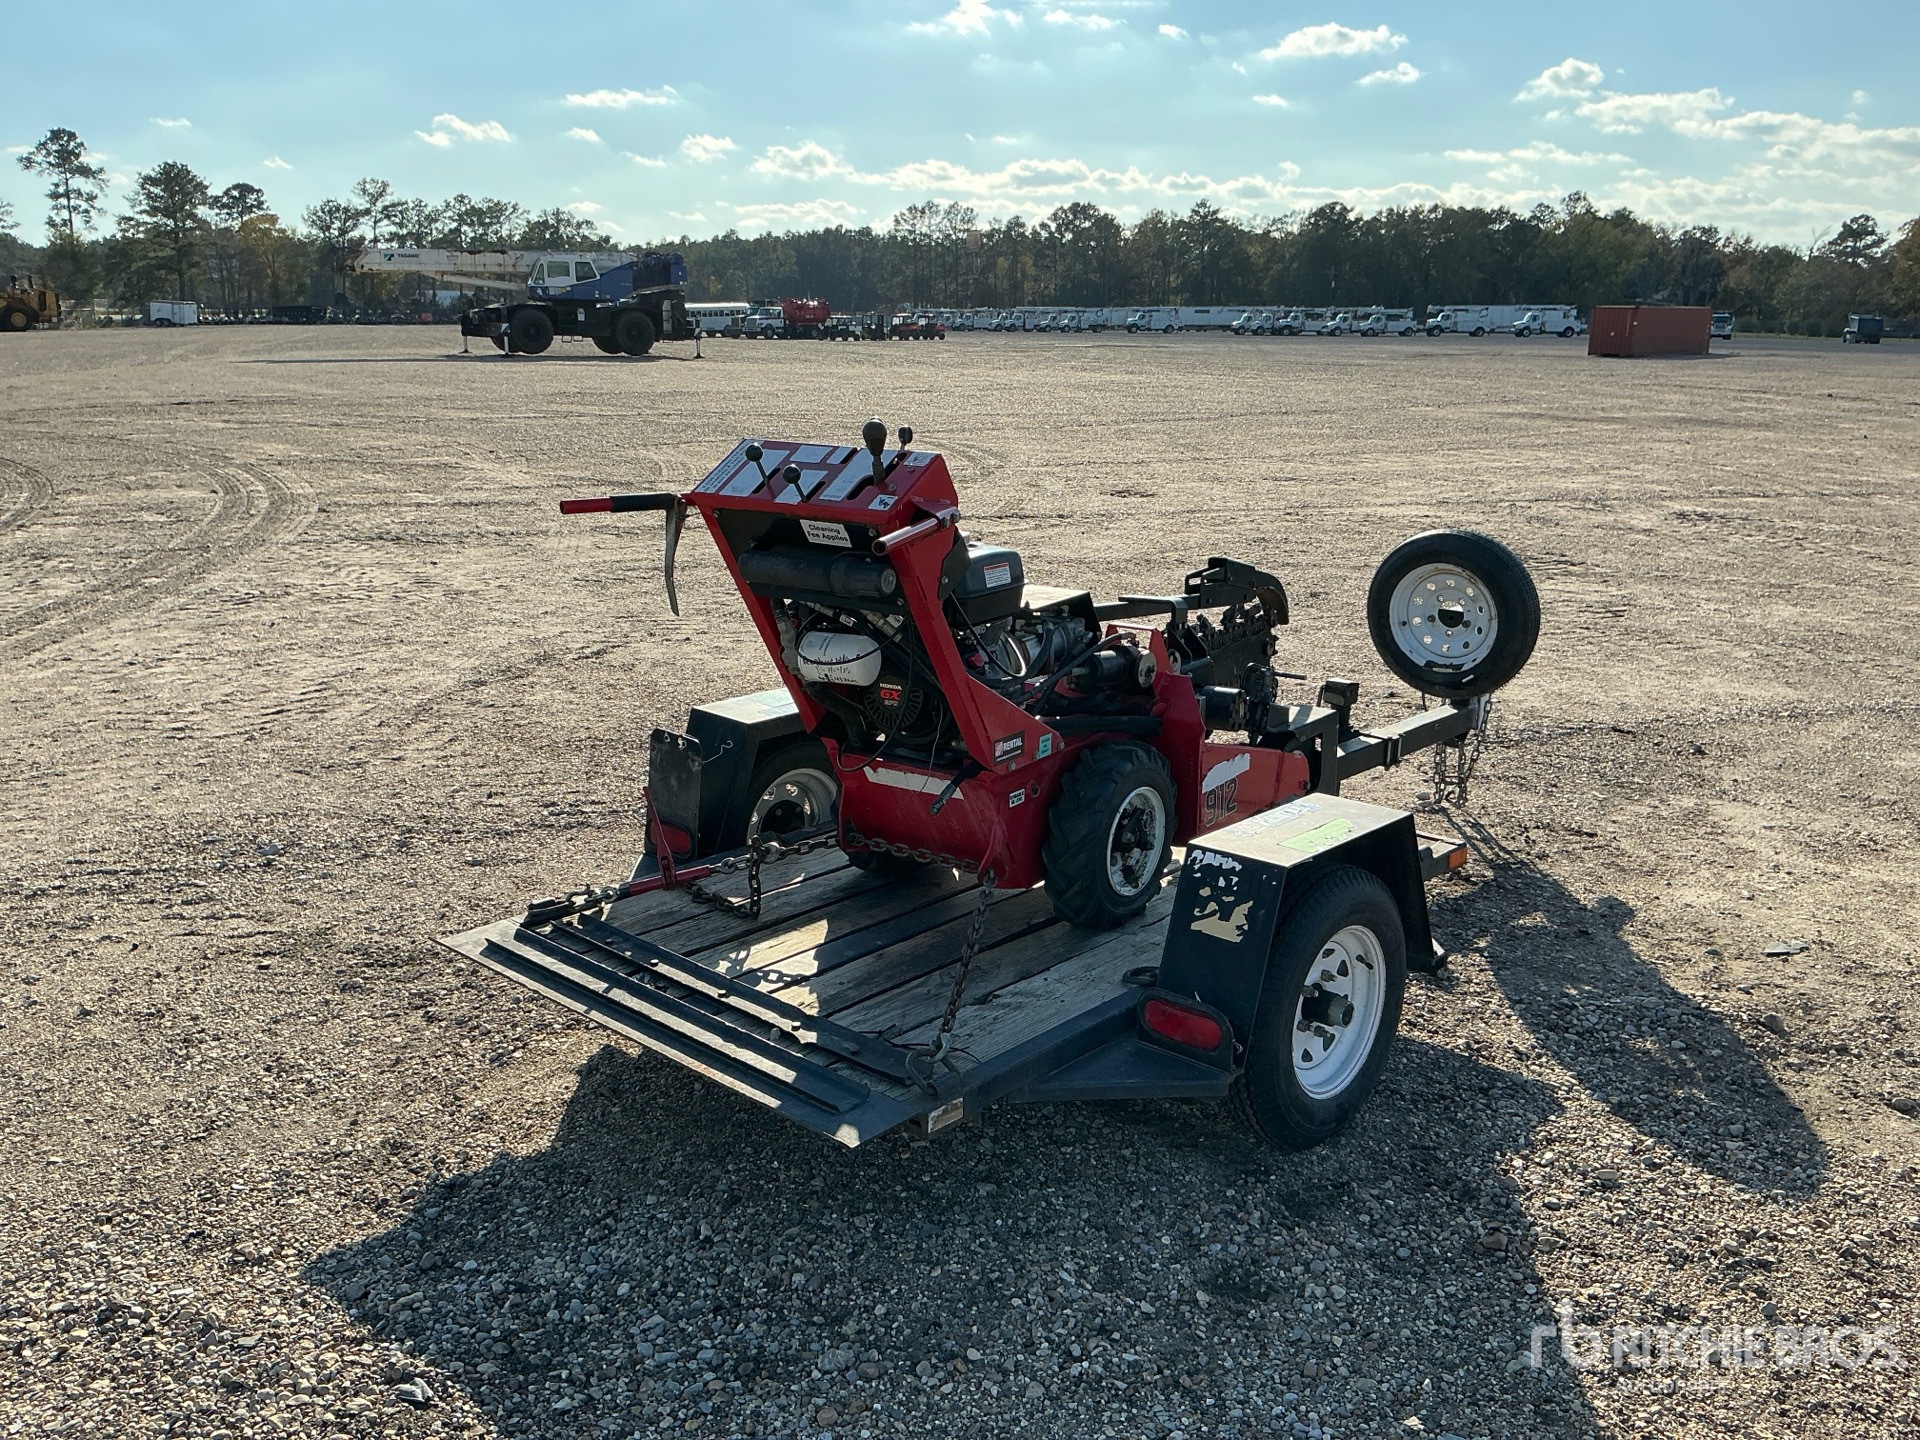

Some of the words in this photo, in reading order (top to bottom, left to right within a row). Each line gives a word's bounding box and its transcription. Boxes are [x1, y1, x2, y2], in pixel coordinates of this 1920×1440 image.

[808, 524, 841, 535] Cleaning
[806, 530, 821, 539] Fee
[822, 532, 849, 542] Applies
[879, 683, 903, 691] HONDA
[880, 689, 901, 700] GX
[1003, 737, 1022, 751] RENTAL
[1205, 776, 1237, 828] 912
